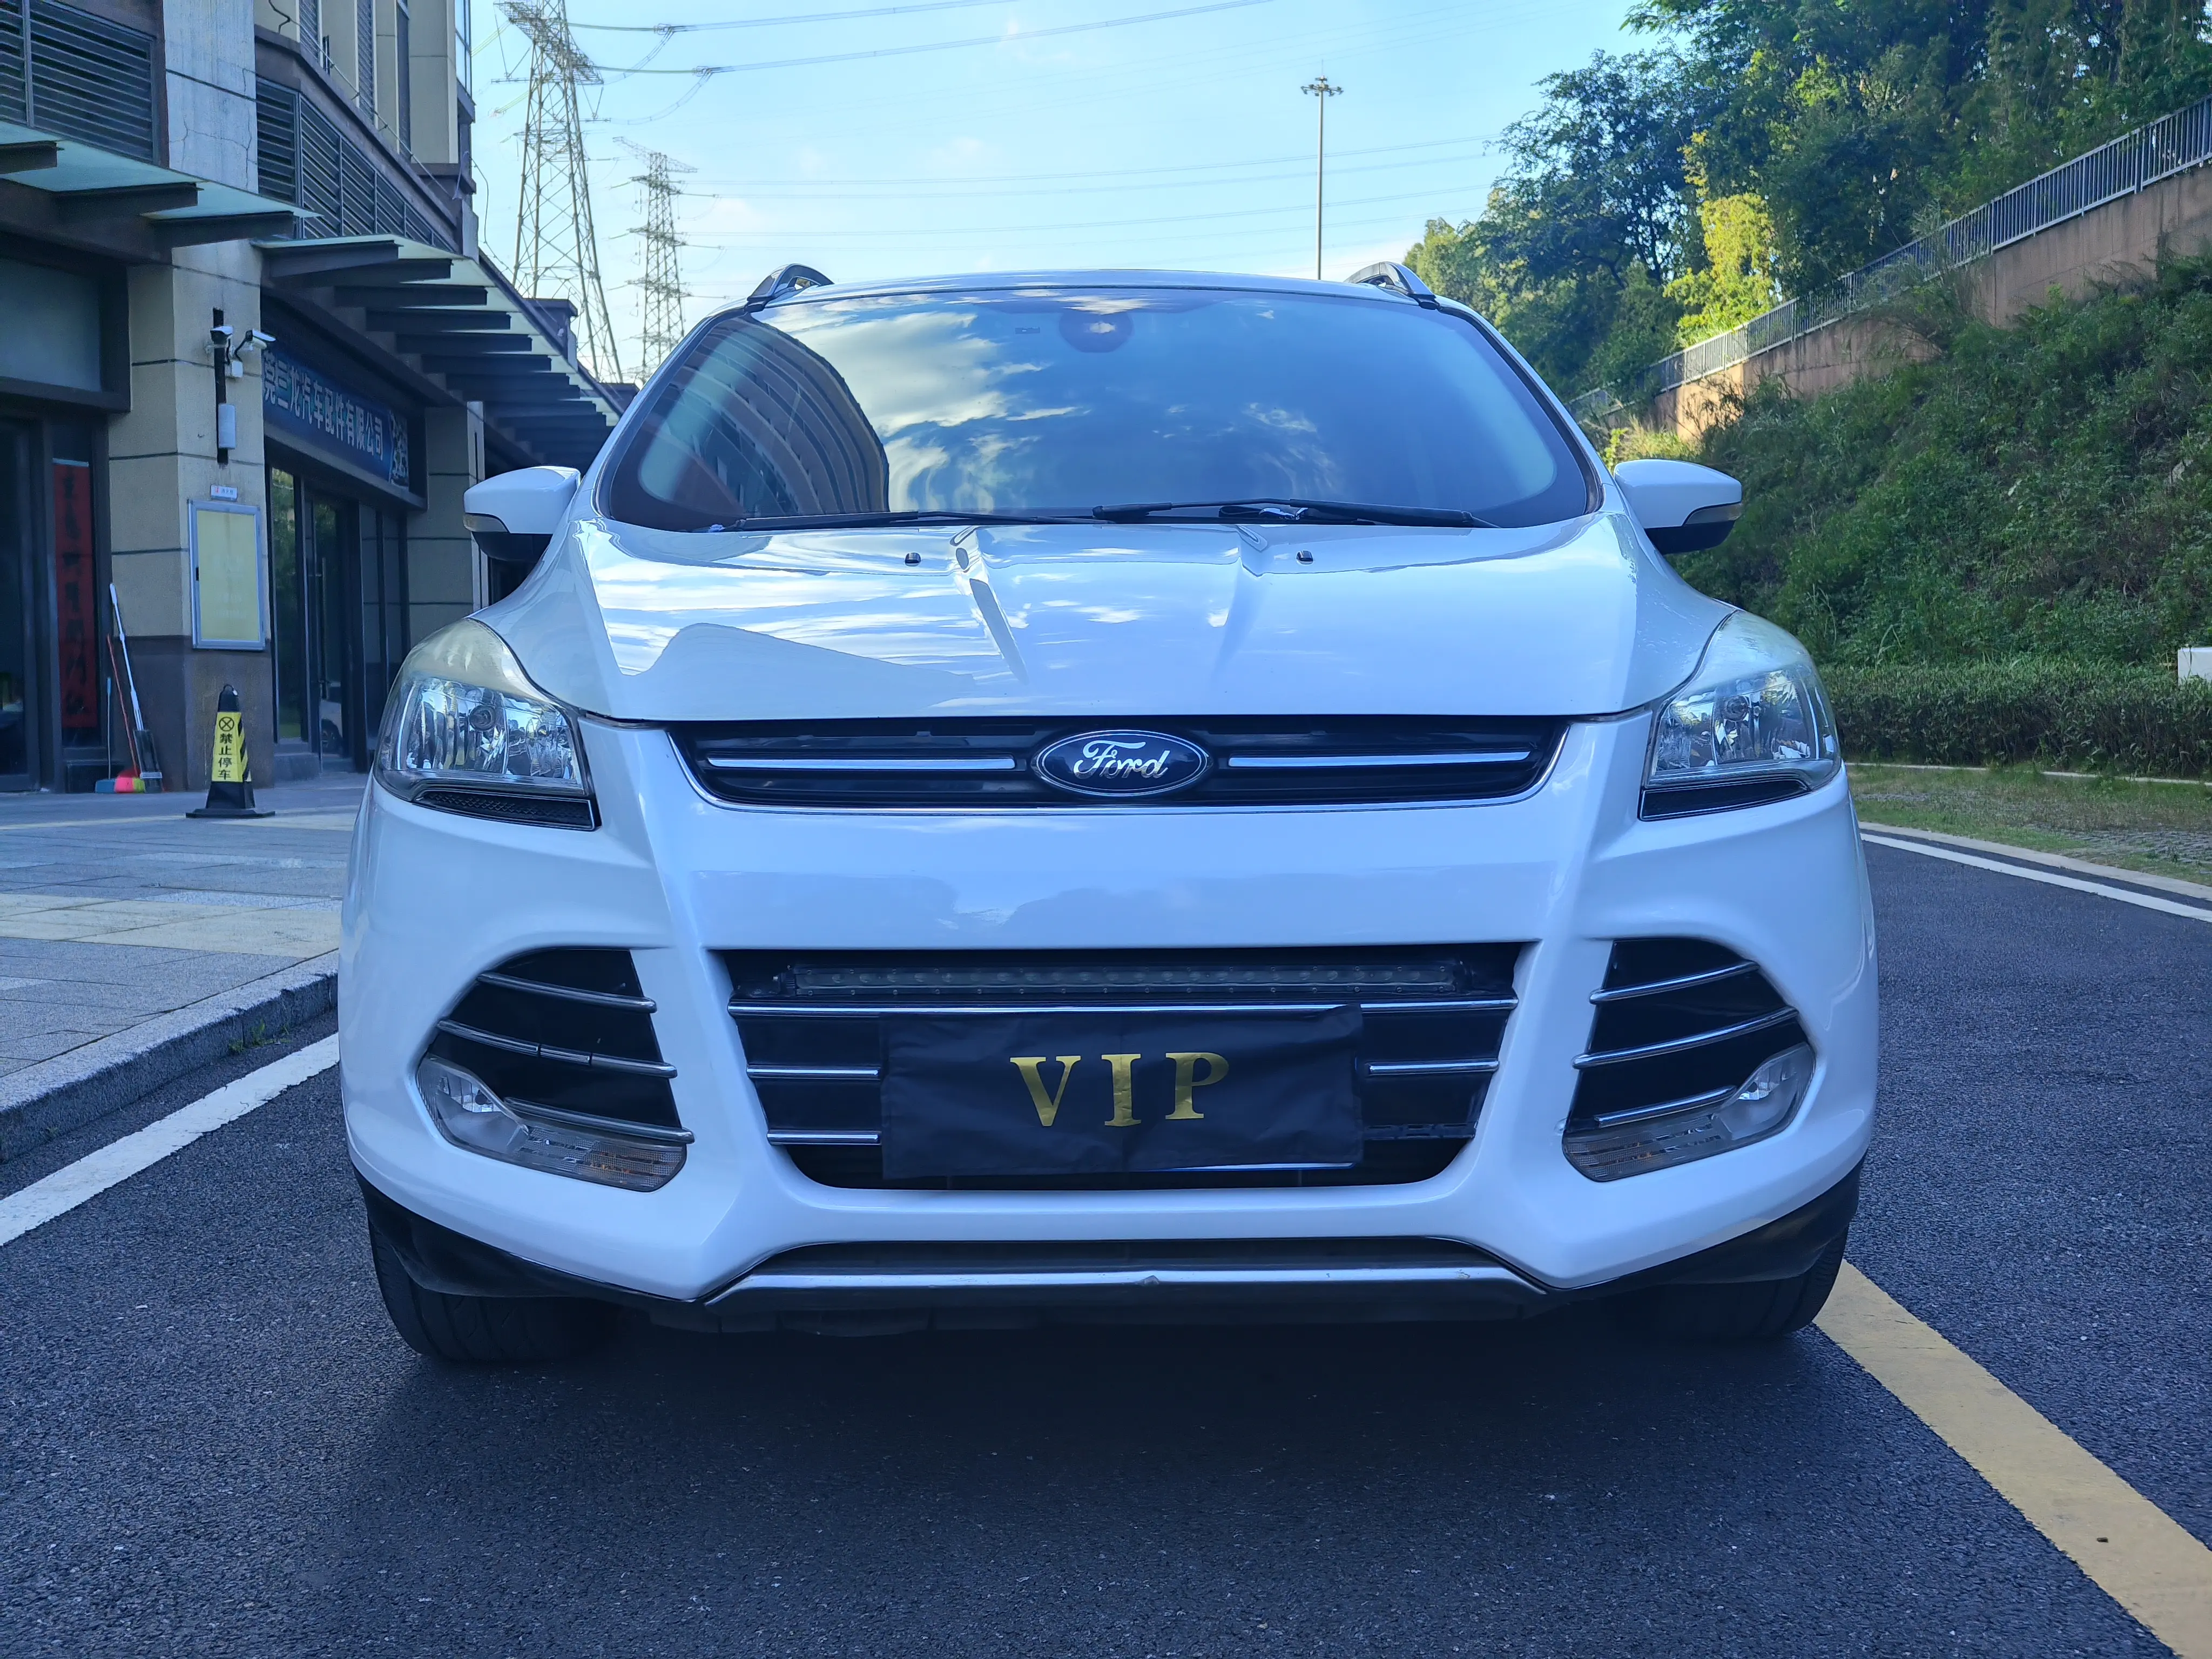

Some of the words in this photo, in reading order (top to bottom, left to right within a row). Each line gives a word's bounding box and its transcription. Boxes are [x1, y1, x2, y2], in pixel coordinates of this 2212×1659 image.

[218, 733, 233, 780] 禁止停车
[1073, 740, 1171, 779] Ford
[1009, 1052, 1230, 1127] VIP
